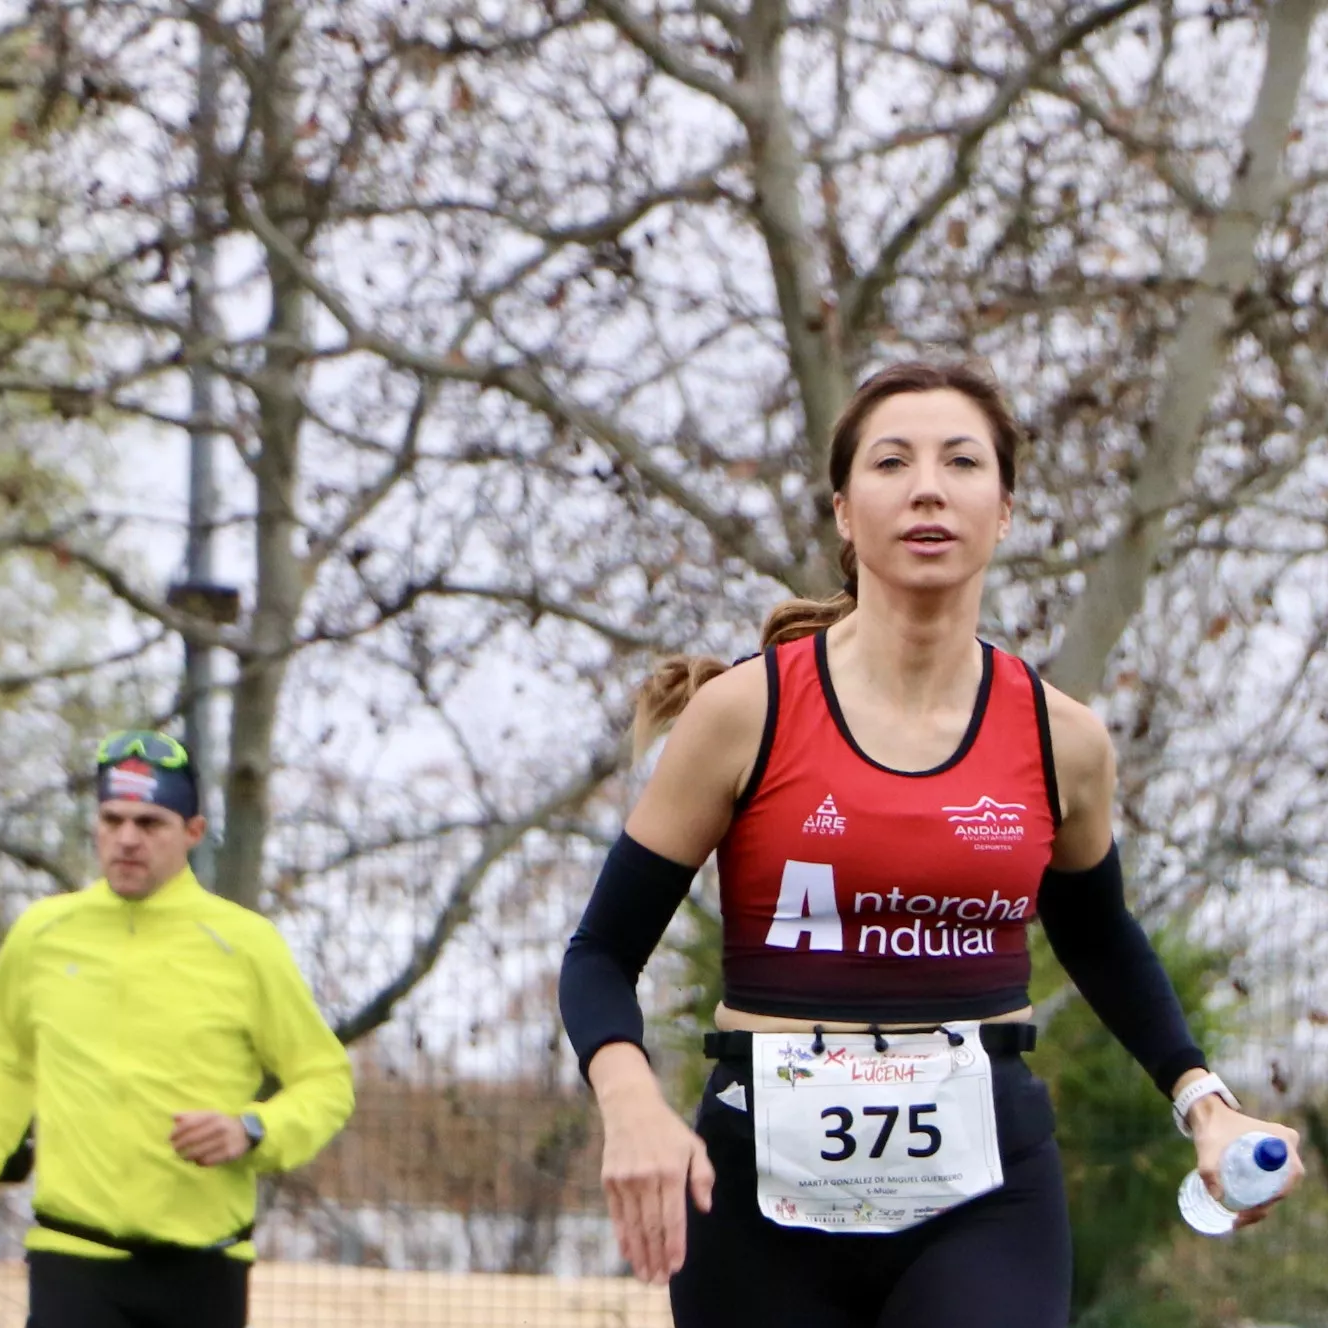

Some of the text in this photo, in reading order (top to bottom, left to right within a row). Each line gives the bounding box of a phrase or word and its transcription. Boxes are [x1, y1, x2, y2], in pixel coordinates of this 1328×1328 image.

[803, 814, 847, 829] AIRE
[954, 823, 1024, 836] ANDÚJAR
[820, 1103, 942, 1162] 375
